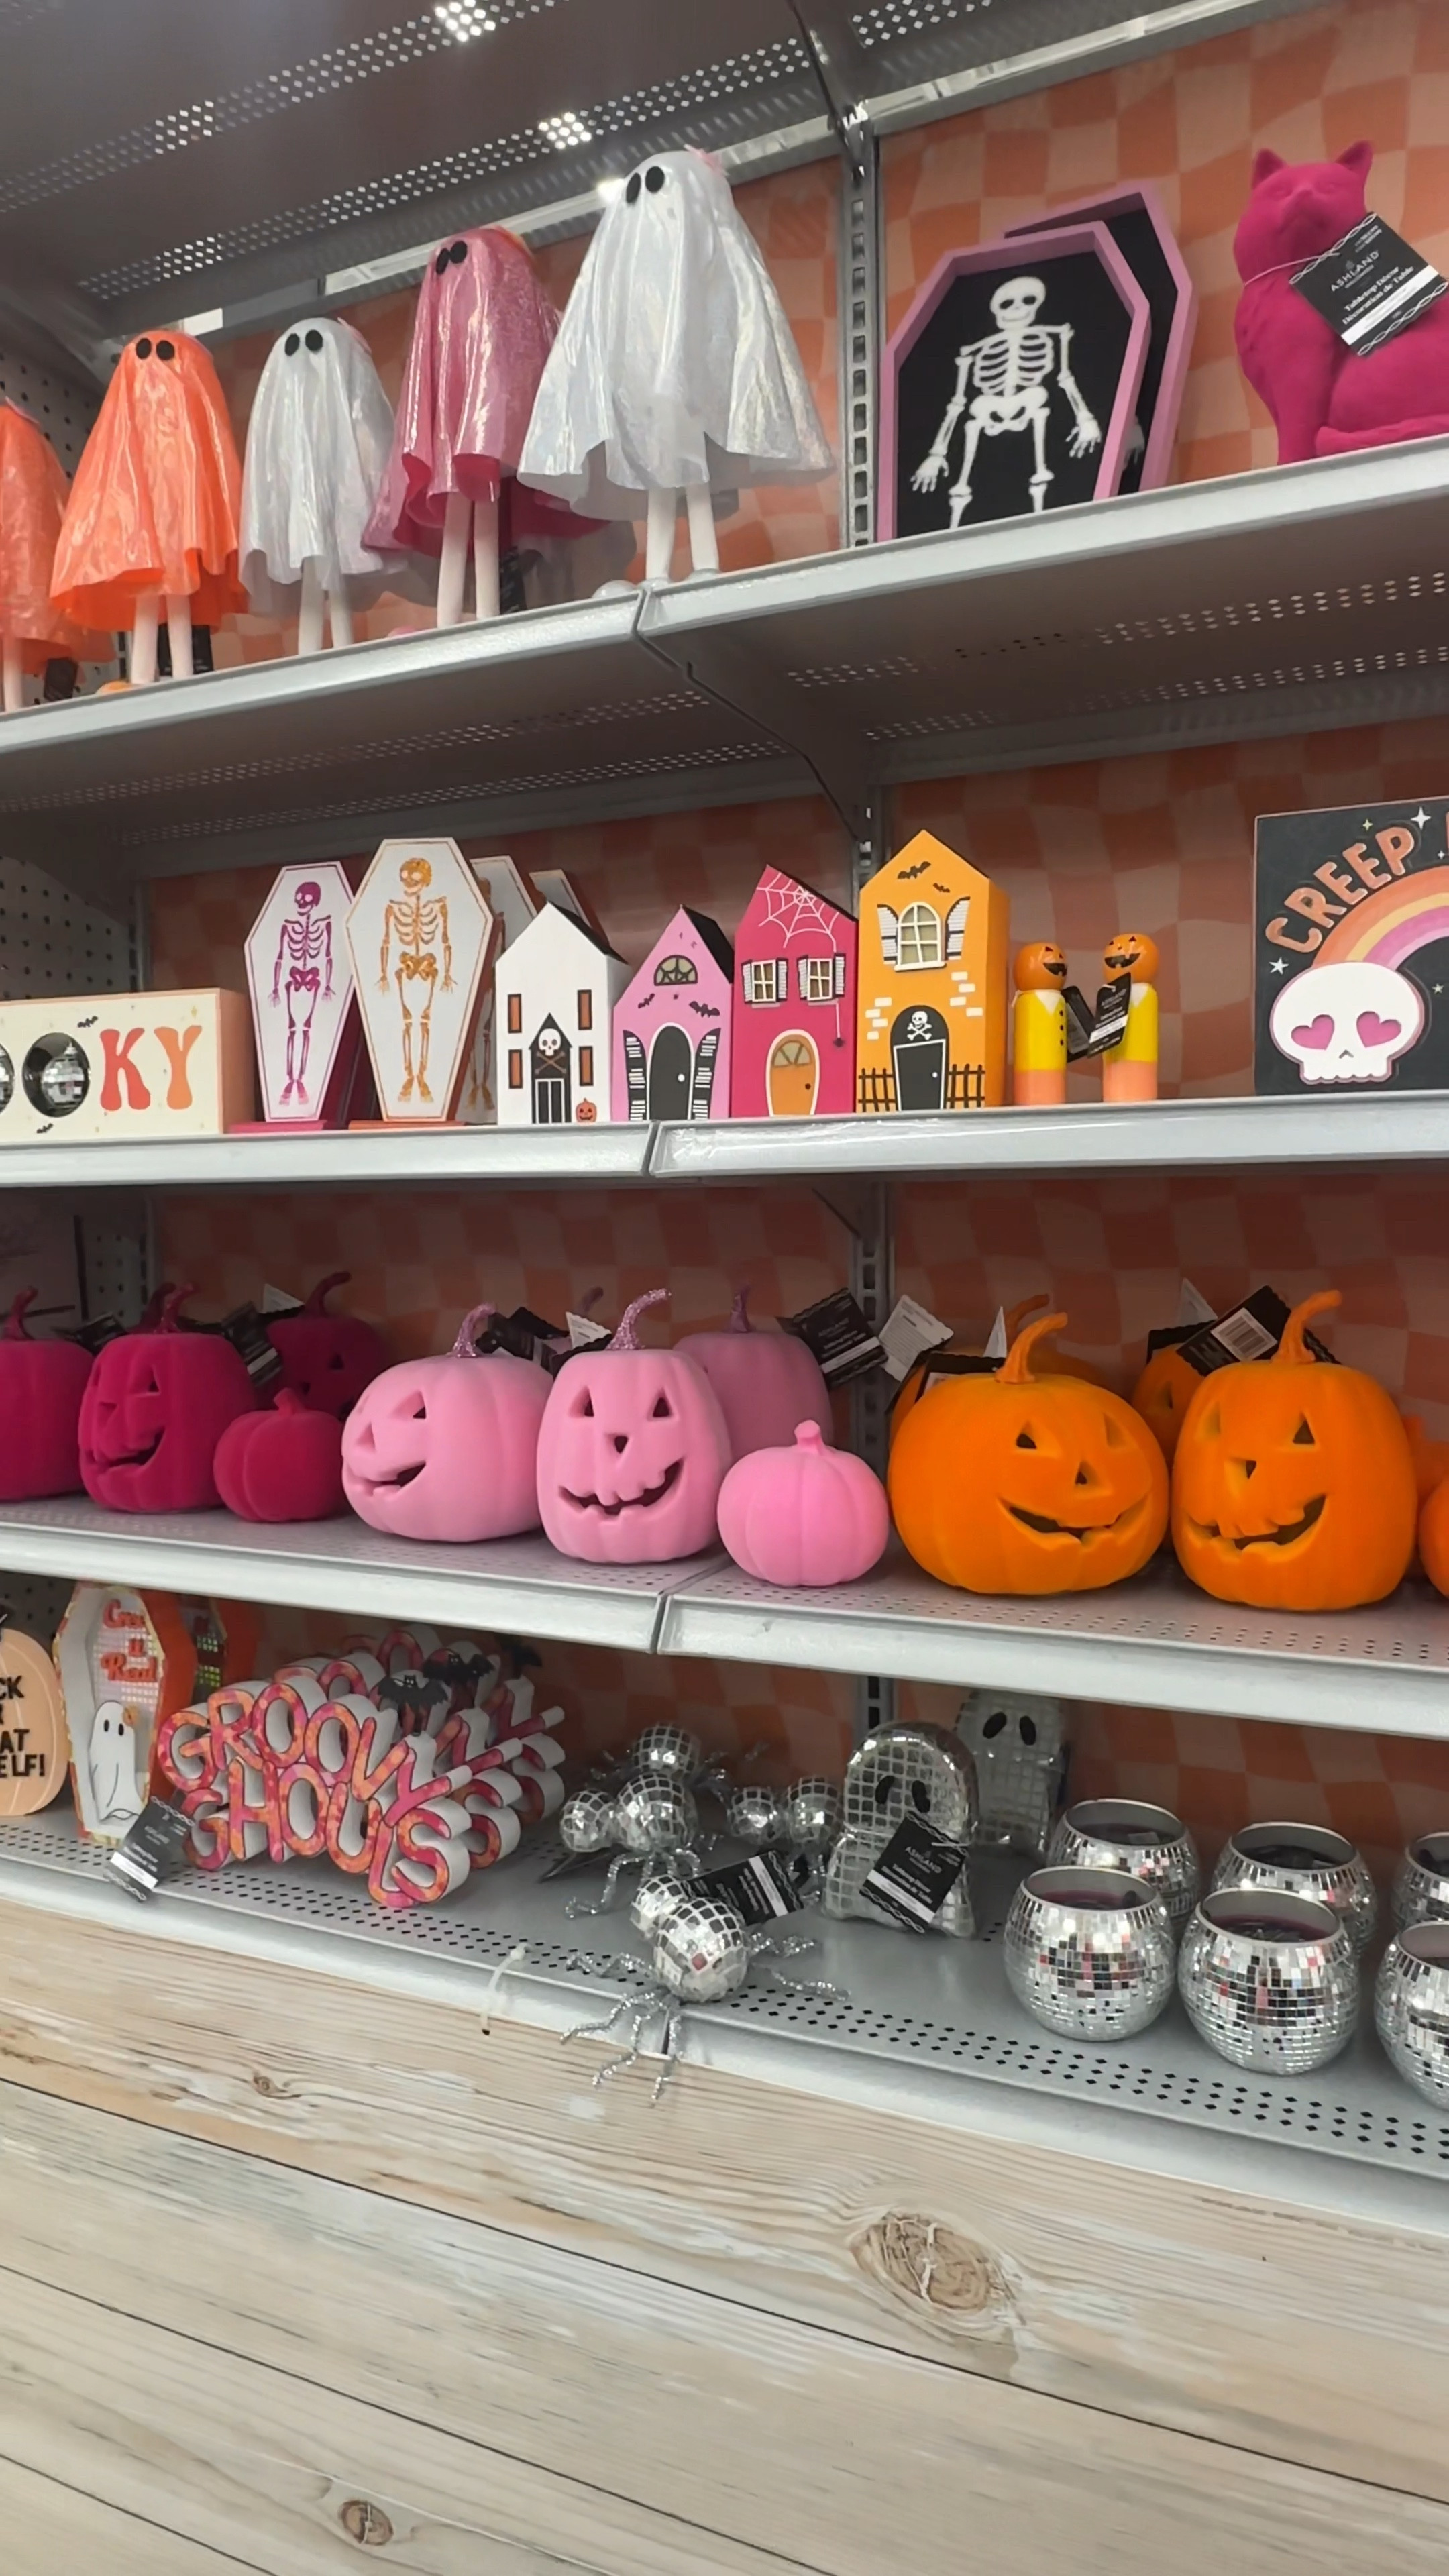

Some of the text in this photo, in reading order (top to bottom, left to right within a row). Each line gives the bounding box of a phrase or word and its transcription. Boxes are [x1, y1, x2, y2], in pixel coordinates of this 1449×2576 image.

[1331, 250, 1379, 292] ASHLAND
[1265, 826, 1415, 953] CREEP
[157, 1682, 452, 1827] GROOVY
[182, 1758, 450, 1907] GHOULS
